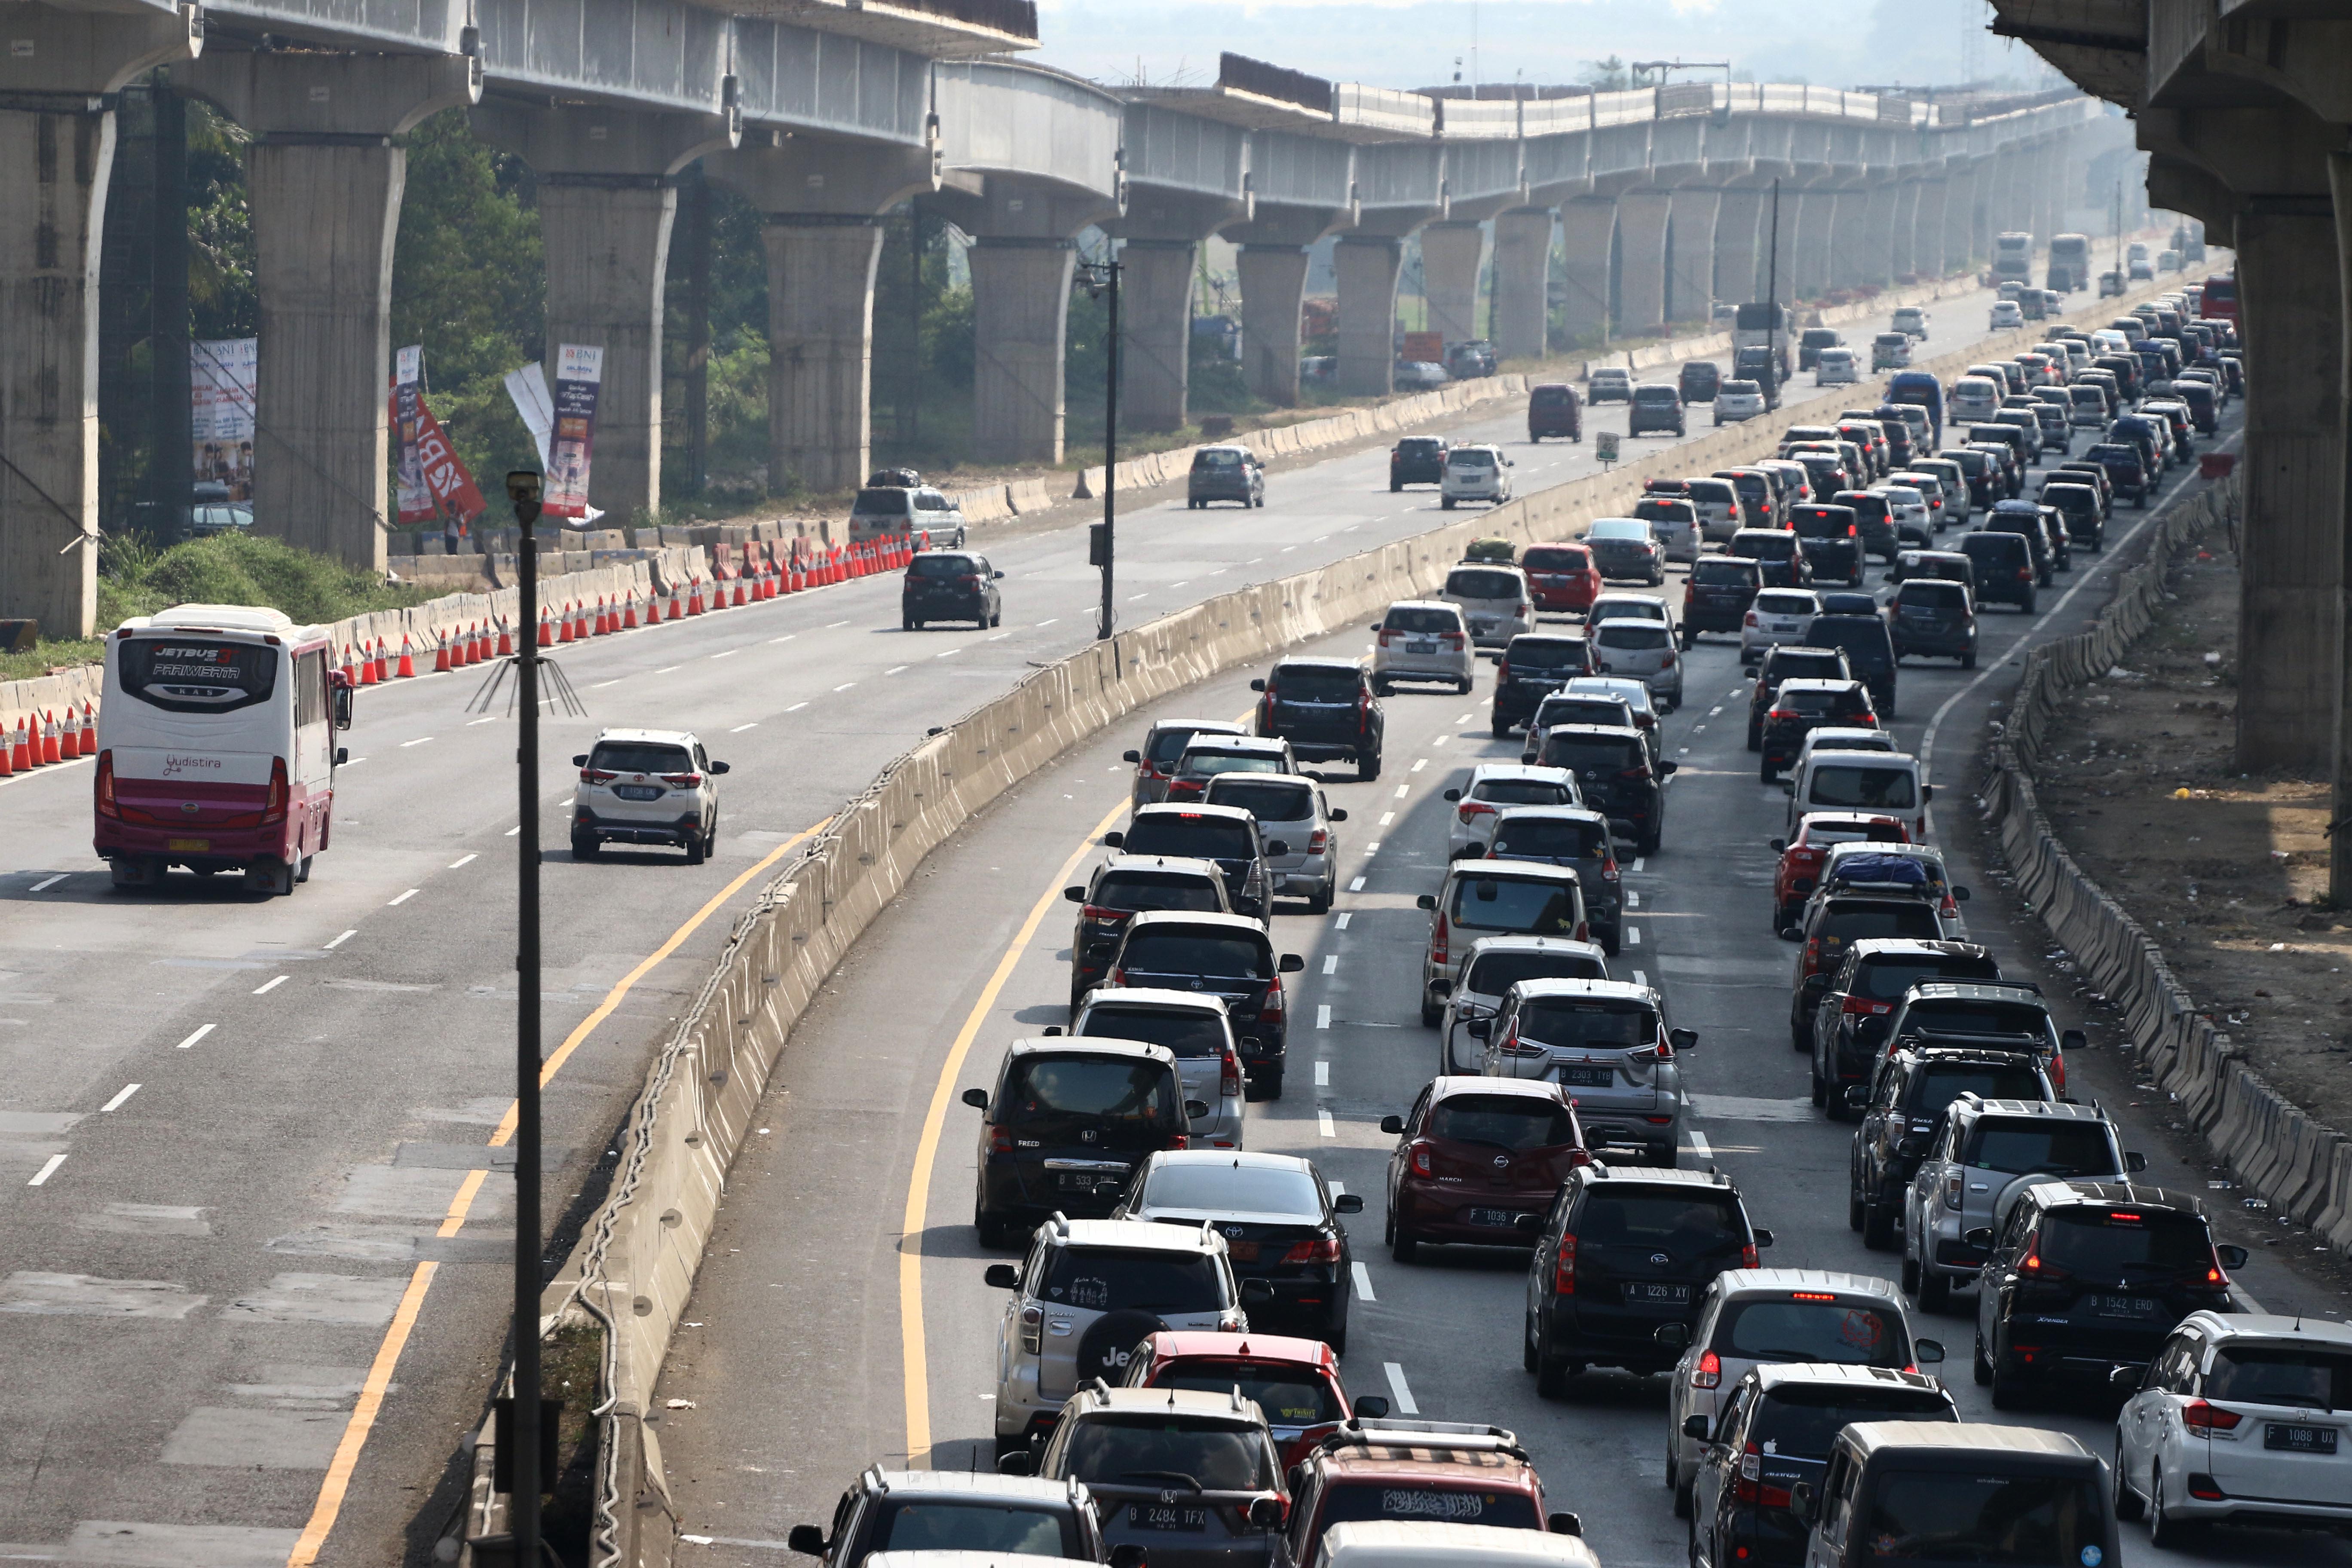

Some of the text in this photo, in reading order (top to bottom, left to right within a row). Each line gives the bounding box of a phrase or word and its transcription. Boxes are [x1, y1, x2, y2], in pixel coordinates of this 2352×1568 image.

[576, 349, 596, 360] BNI
[153, 664, 240, 678] PARIWISATA
[163, 754, 220, 776] Yudistira
[1561, 1070, 1611, 1080] B 2303 TYB
[1059, 1175, 1065, 1185] B
[1075, 1176, 1091, 1185] 533
[1470, 1210, 1477, 1219] F
[1487, 1210, 1506, 1221] 1036
[1630, 1284, 1687, 1298] A 1226 XY
[2091, 1295, 2153, 1311] B 1542 ERD
[1102, 1346, 1130, 1367] Je
[2268, 1427, 2334, 1444] F 1088 UX
[1130, 1507, 1204, 1525] B 2484 TFX
